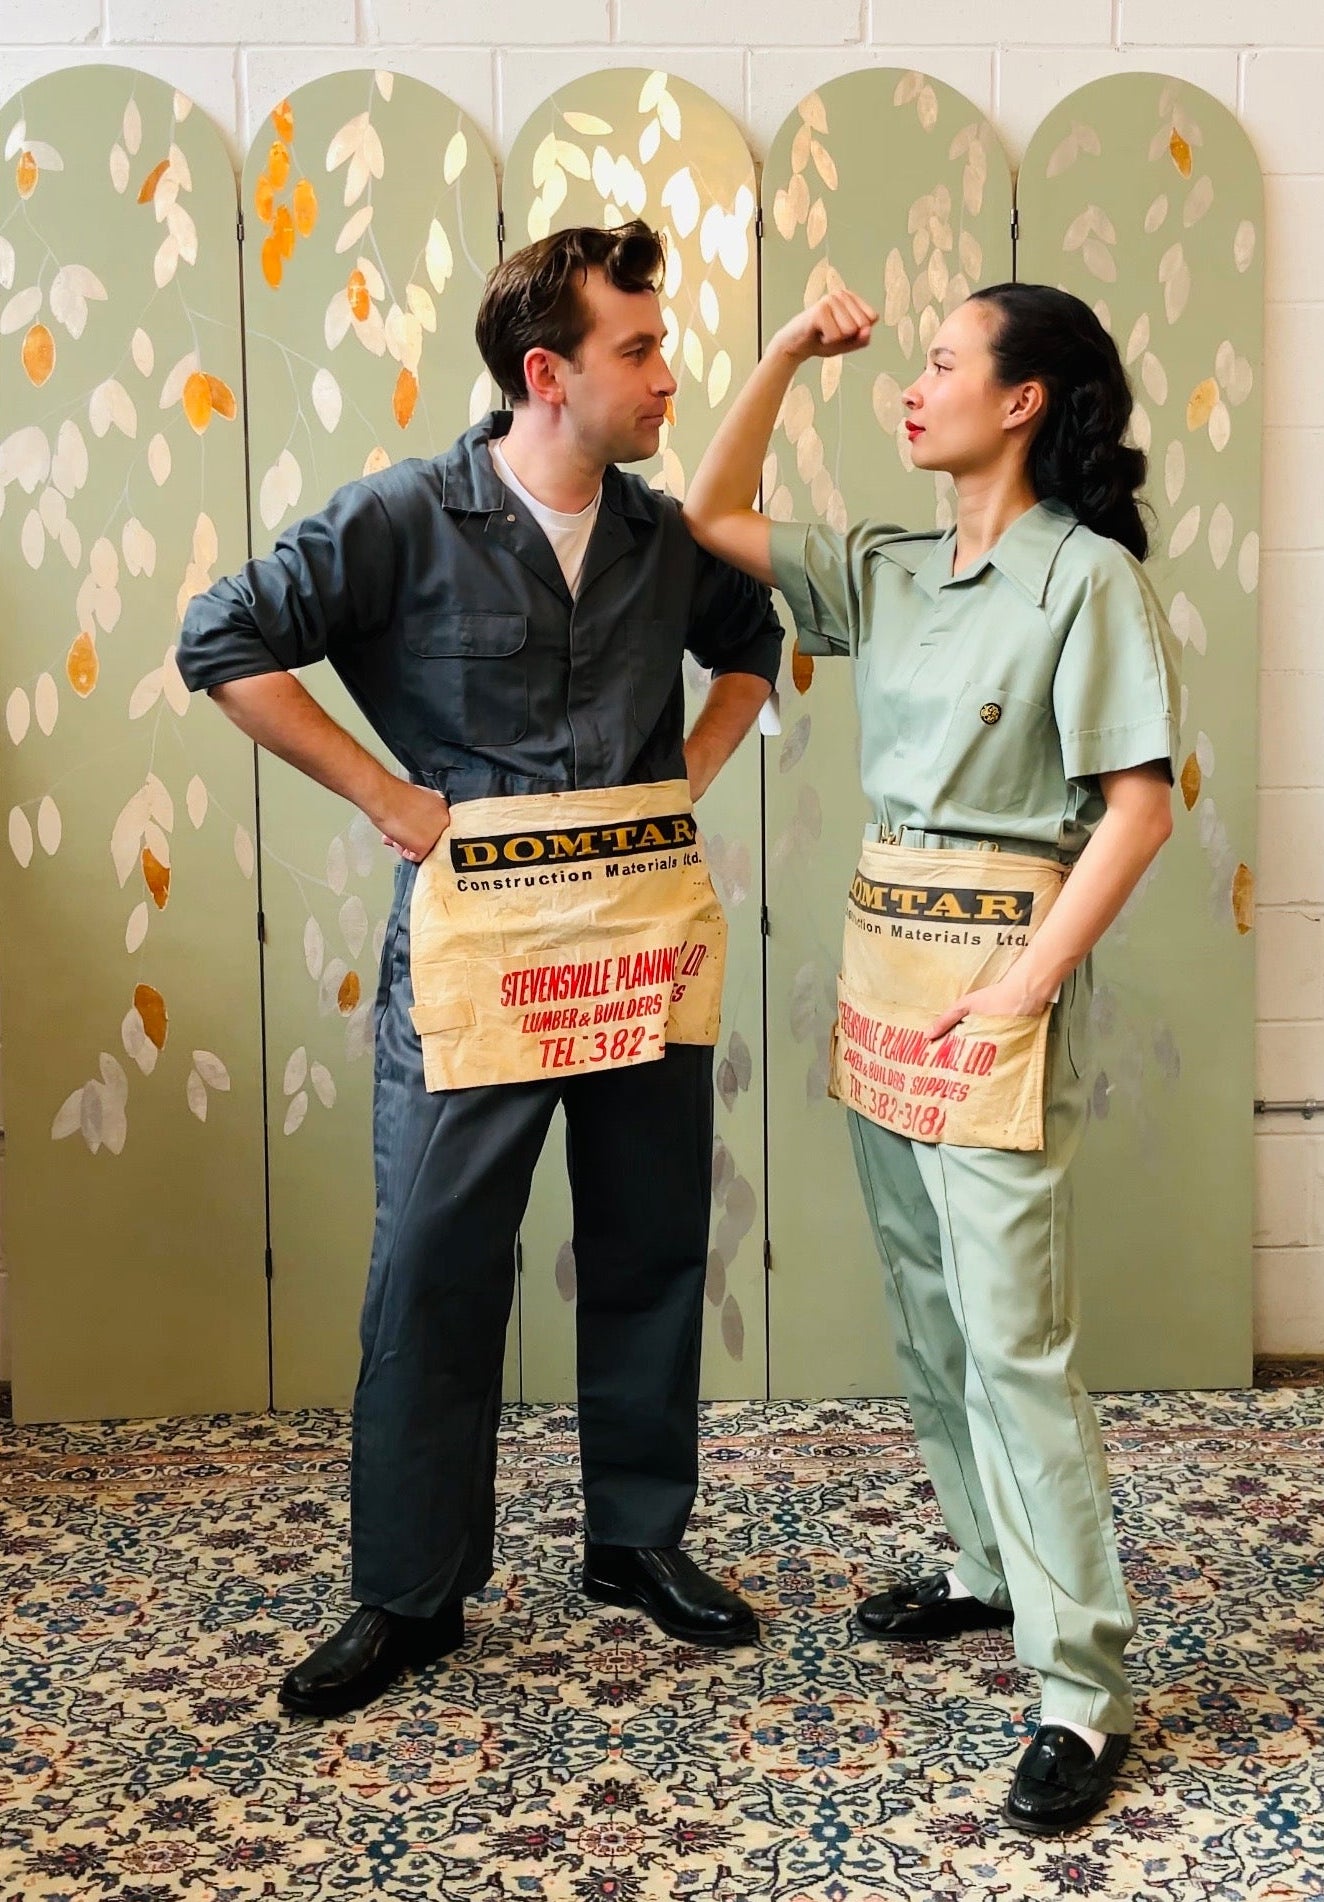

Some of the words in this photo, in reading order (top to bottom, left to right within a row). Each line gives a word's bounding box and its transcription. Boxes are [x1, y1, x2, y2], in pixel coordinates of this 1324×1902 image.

[457, 819, 695, 867] DOMTAR
[457, 869, 593, 892] Construction
[605, 855, 678, 878] Materials
[850, 877, 1024, 921] OMTAR
[891, 924, 981, 945] Materials
[995, 931, 1029, 947] Ltd.
[501, 958, 613, 1007] STEVENSVILLE
[521, 1007, 577, 1034] LUMBER
[580, 1012, 591, 1026] &
[593, 993, 662, 1025] BUILDERS
[588, 1022, 667, 1063] 382-
[962, 1041, 997, 1077] LTD.
